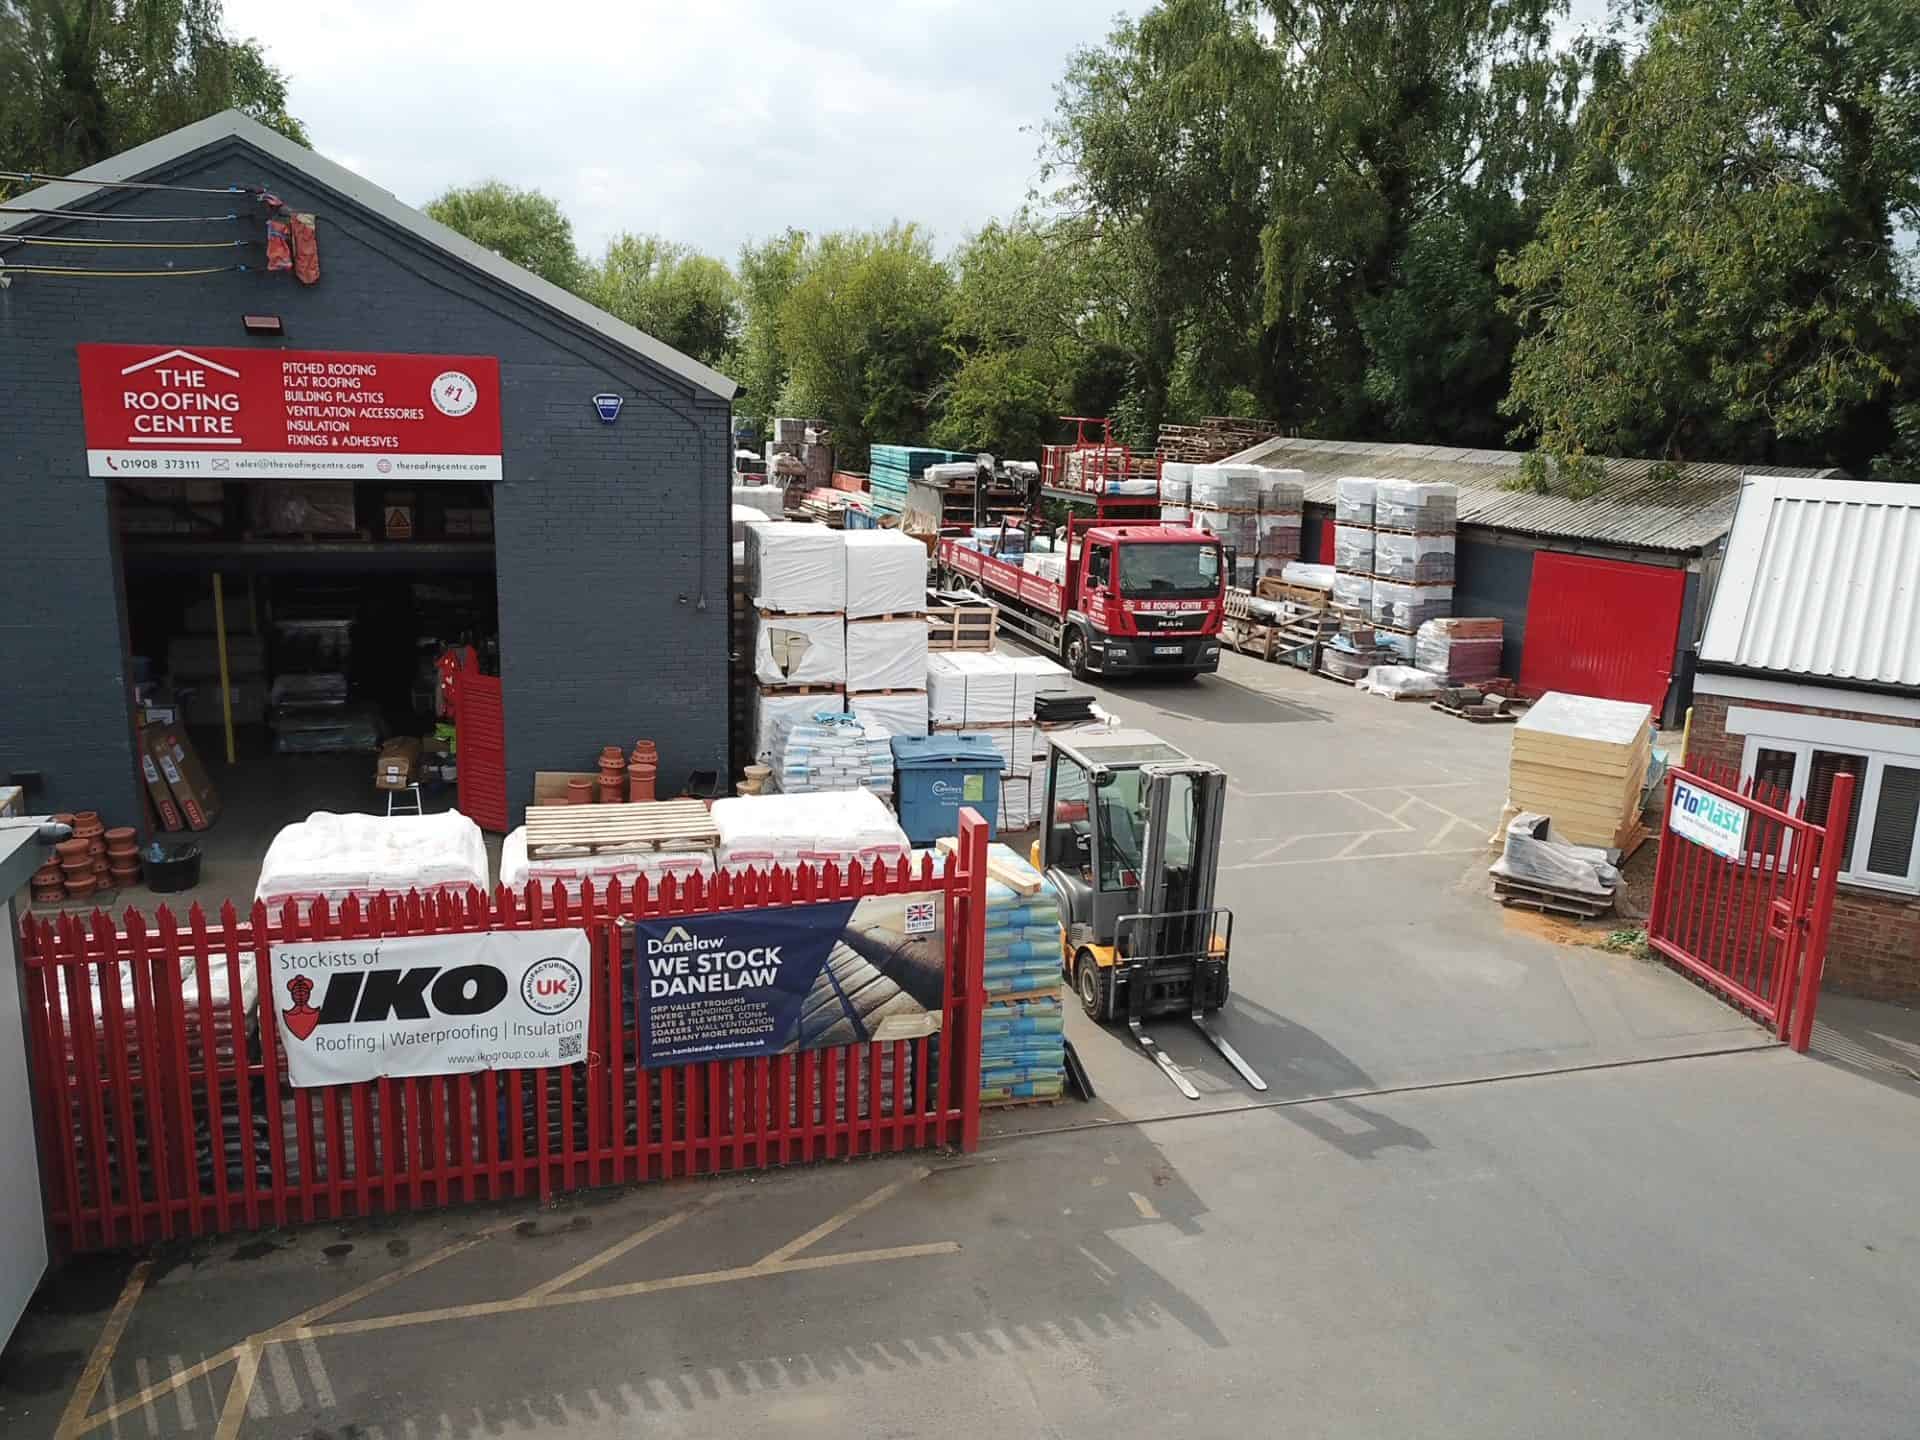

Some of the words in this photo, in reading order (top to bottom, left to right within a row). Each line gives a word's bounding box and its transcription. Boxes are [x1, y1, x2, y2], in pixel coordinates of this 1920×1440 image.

[282, 362, 325, 374] PITCHED
[328, 364, 377, 376] ROOFING
[155, 369, 206, 388] THE
[283, 376, 309, 387] FLAT
[312, 377, 361, 388] ROOFING
[123, 391, 240, 412] ROOFING
[284, 391, 332, 402] BUILDING
[336, 392, 384, 404] PLASTICS
[286, 405, 356, 417] VENTILATION
[359, 408, 424, 420] ACCESSORIES
[134, 414, 234, 434] CENTRE
[287, 420, 350, 432] INSULATION
[288, 434, 328, 446] FIXINGS
[332, 437, 339, 446] &
[342, 436, 399, 447] ADHESIVES
[121, 459, 158, 470] 01908
[165, 459, 200, 470] 373111
[235, 459, 364, 470] sales@theroofingcentre.com
[397, 460, 487, 471] theroofingcentre.com
[1141, 601, 1151, 610] THE
[1153, 601, 1179, 610] ROOFING
[1181, 601, 1202, 610] CENTRE
[1674, 785, 1742, 835] FloPlast
[647, 935, 725, 954] Danelaw
[280, 952, 357, 970] Stockists
[363, 948, 381, 965] of
[648, 957, 690, 977] WE
[697, 946, 783, 973] STOCK
[527, 962, 572, 1000] MANUFACTURING
[536, 979, 568, 996] UK
[650, 967, 778, 998] DANELAW
[318, 964, 508, 1025] IKO
[670, 1001, 702, 1012] VALLEY
[703, 997, 745, 1008] TROUGHS
[691, 1005, 731, 1017] BONDING
[651, 1020, 677, 1030] SLATE
[688, 1017, 705, 1026] TILE
[706, 1014, 734, 1023] VENTS
[651, 1026, 692, 1038] SOAKERS
[695, 1023, 718, 1032] WALL
[720, 1016, 775, 1029] VENTILATION
[316, 1033, 376, 1053] Roofing
[390, 1023, 498, 1047] Waterproofing
[513, 1019, 583, 1036] Insulation
[652, 1037, 672, 1045] AND
[673, 1033, 699, 1043] MANY
[701, 1030, 728, 1039] MORE
[729, 1024, 774, 1035] PRODUCTS
[448, 1049, 551, 1064] www.ikogroup.co.uk
